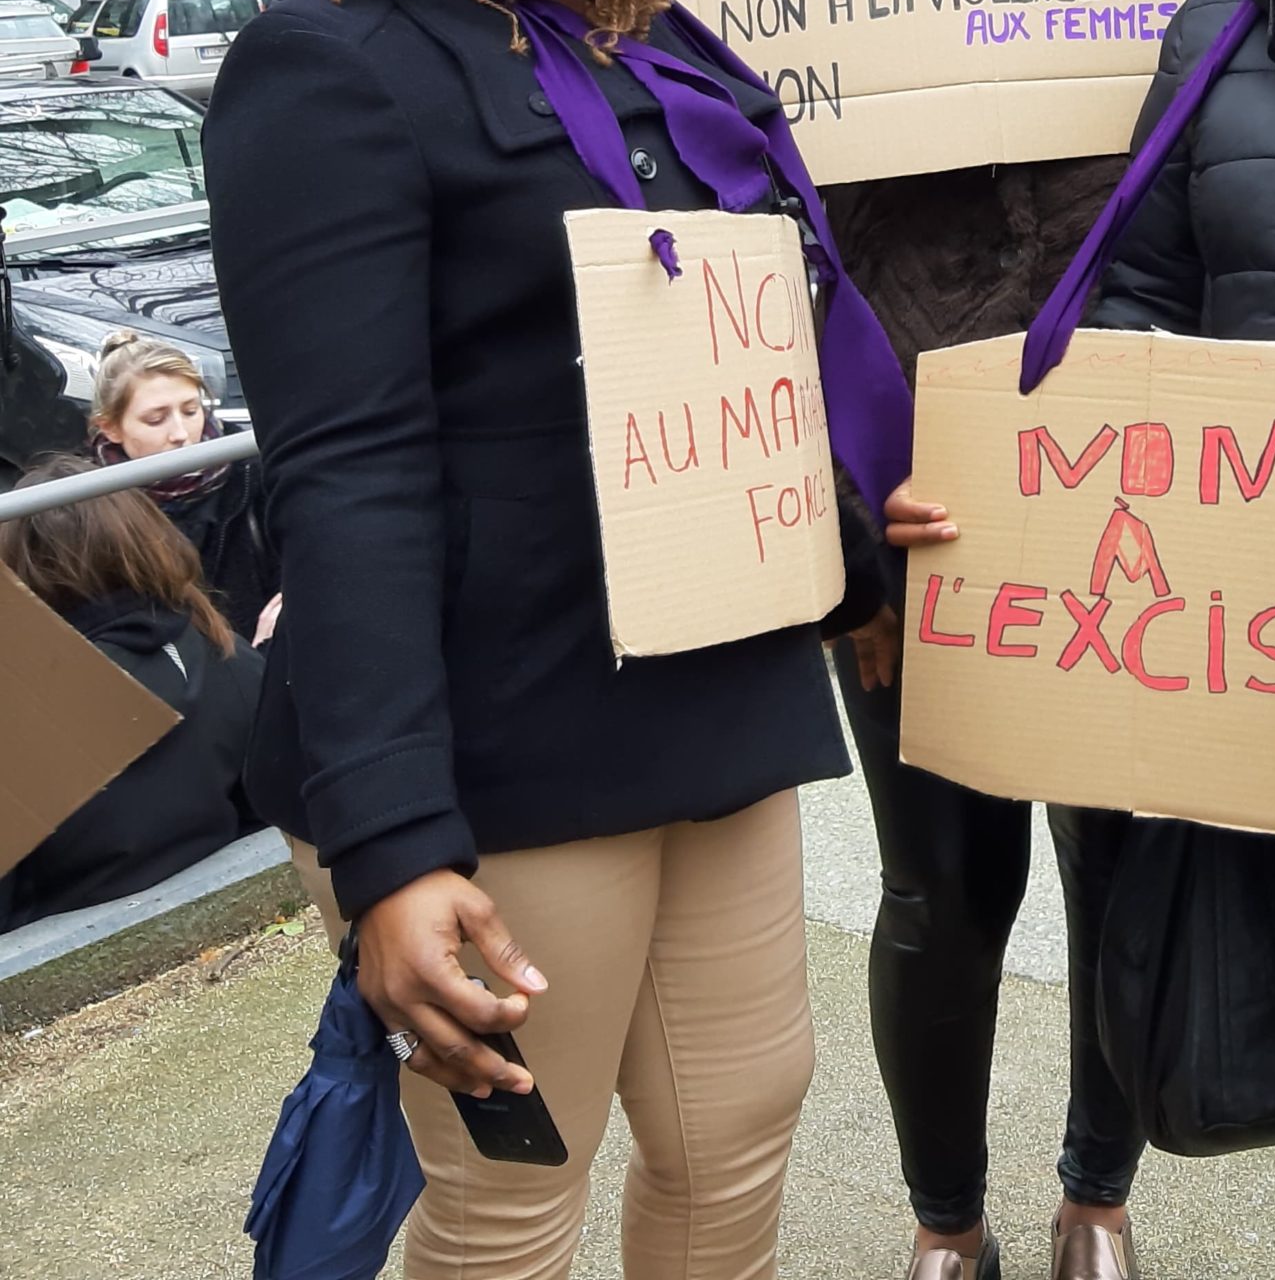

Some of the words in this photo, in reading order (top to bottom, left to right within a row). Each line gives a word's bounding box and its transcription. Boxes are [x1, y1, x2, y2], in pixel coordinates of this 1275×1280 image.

[965, 9, 1031, 46] AUX
[763, 61, 842, 126] ON
[701, 248, 810, 366] NON
[624, 402, 700, 490] AU
